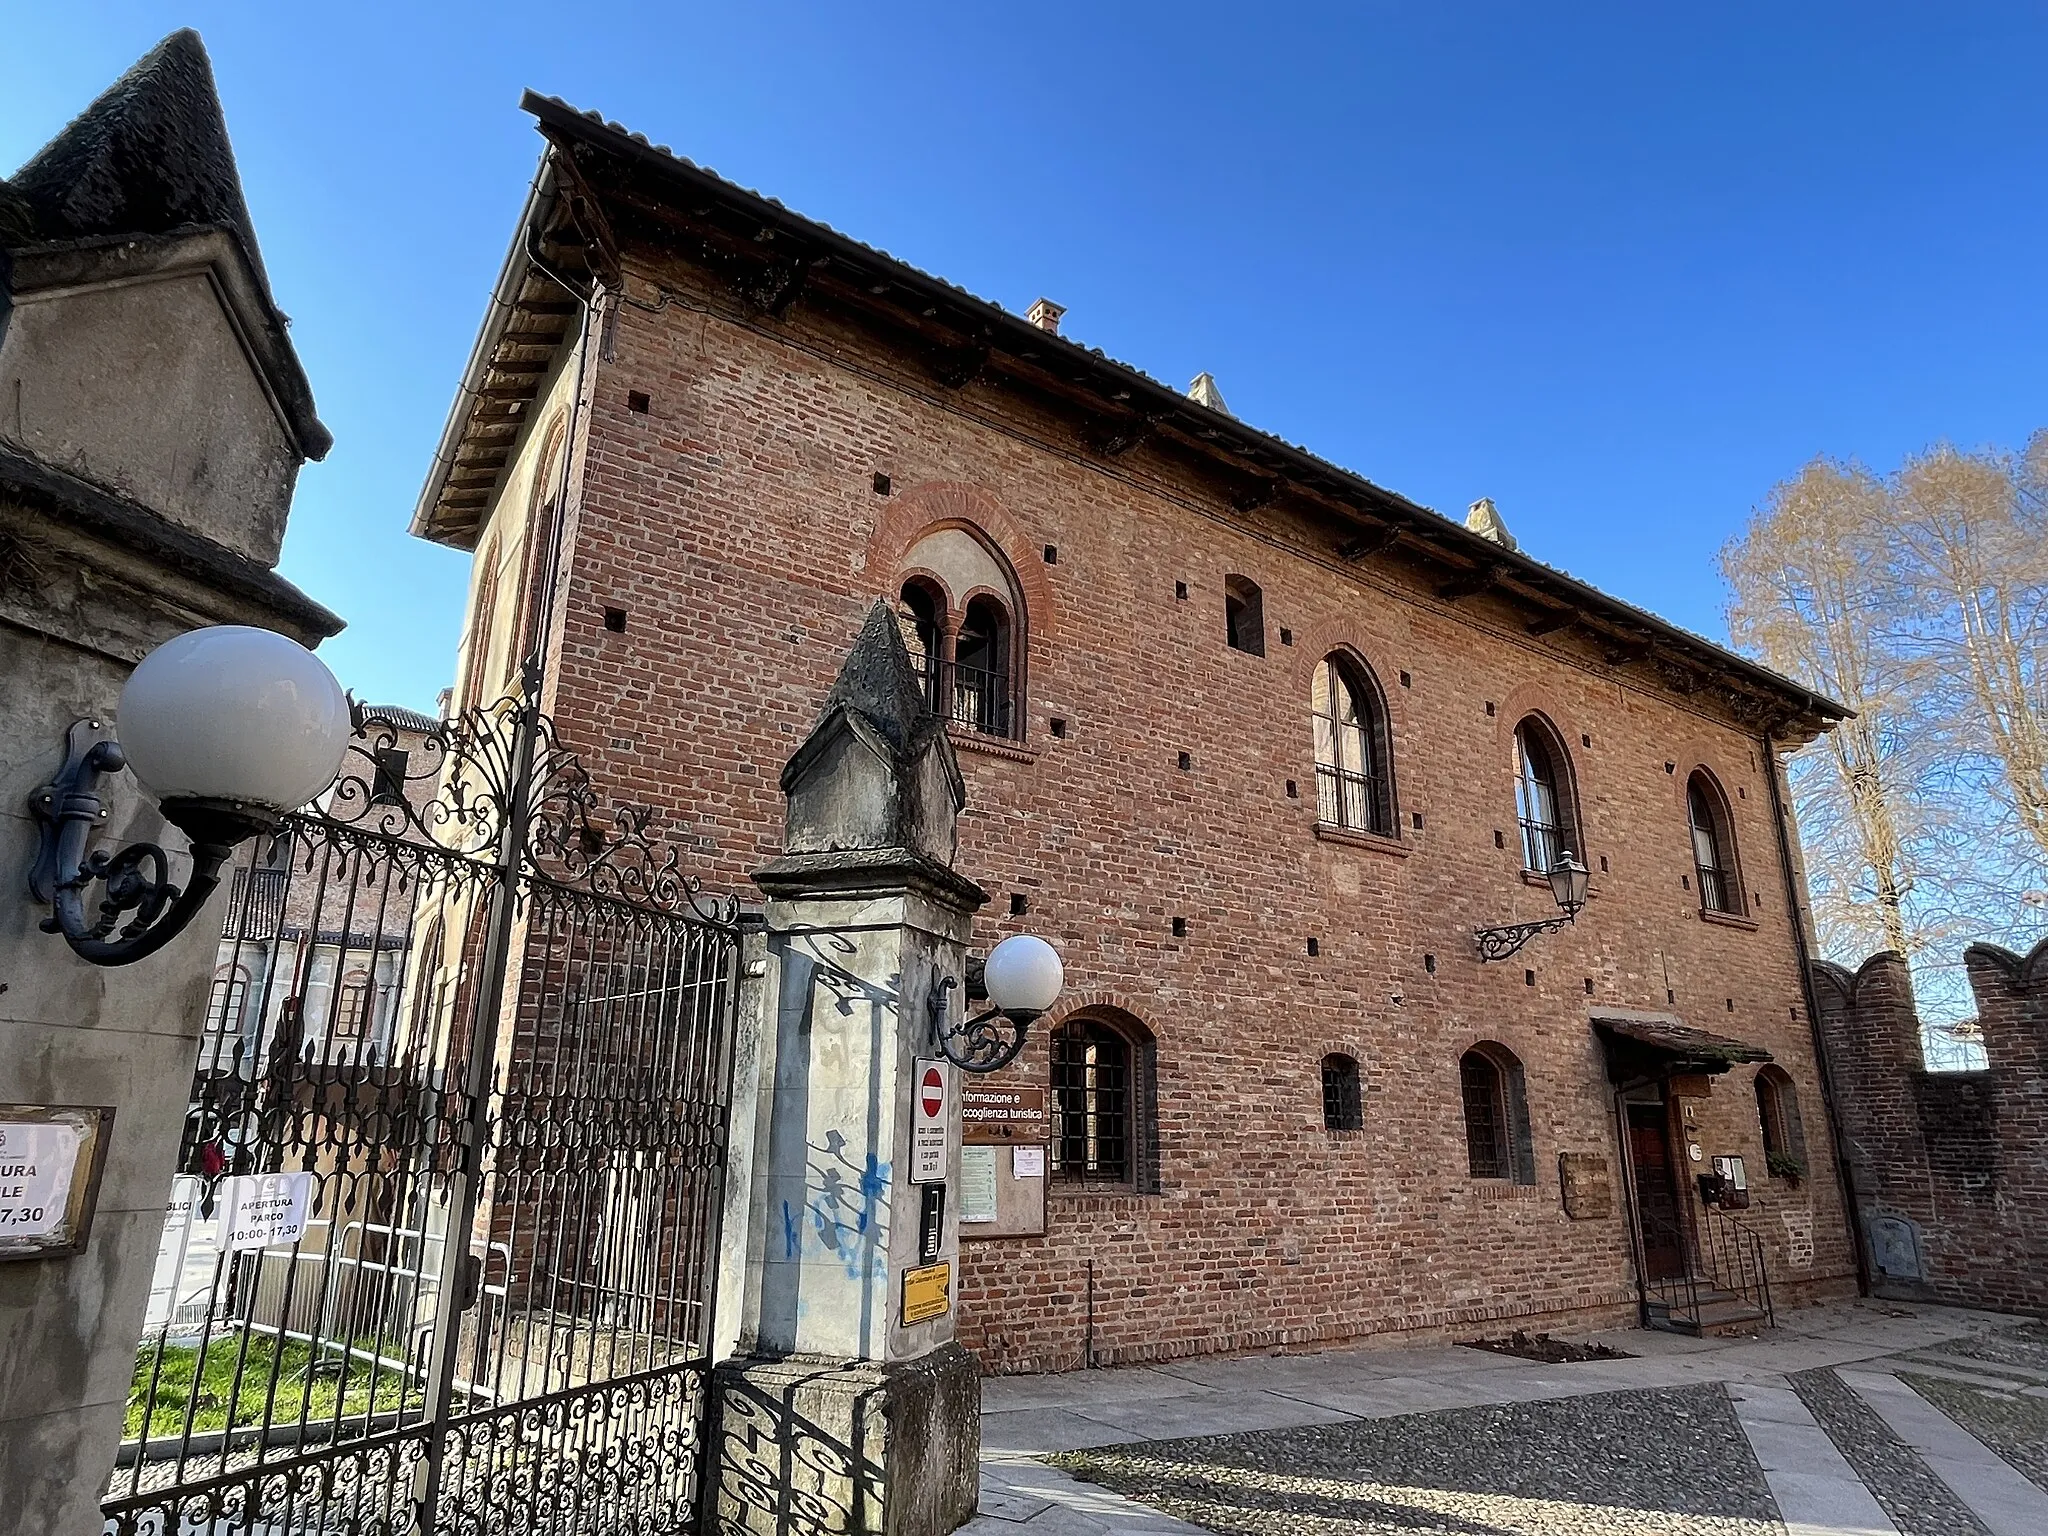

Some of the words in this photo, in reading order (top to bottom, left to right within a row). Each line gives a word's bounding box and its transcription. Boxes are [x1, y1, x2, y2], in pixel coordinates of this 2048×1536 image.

[1014, 1094, 1021, 1104] e
[1010, 1107, 1043, 1119] turistica
[240, 1198, 293, 1211] APERTURA
[250, 1212, 284, 1223] PARCO
[270, 1224, 298, 1238] 17,30
